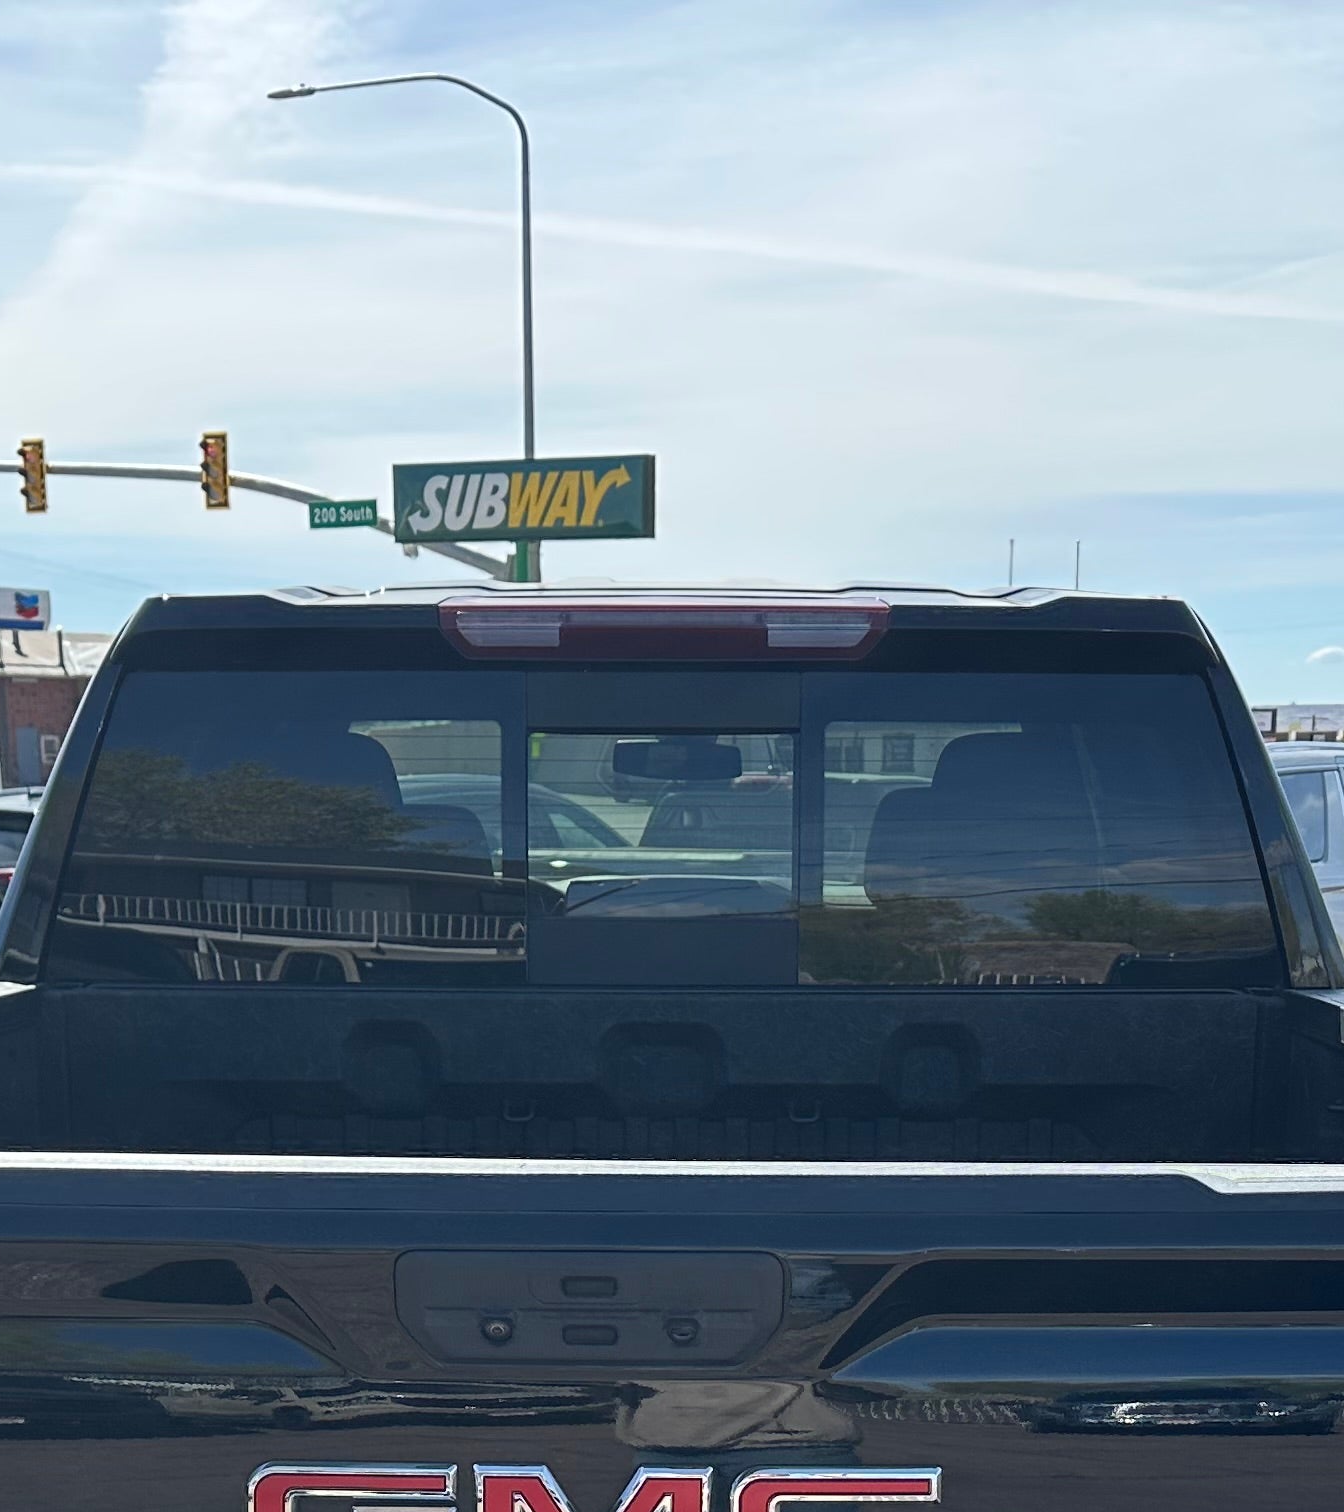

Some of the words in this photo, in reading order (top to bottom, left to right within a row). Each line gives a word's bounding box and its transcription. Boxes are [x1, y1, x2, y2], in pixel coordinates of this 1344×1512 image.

[313, 506, 336, 522] 200
[339, 505, 373, 522] South
[408, 465, 632, 535] SUBWAY
